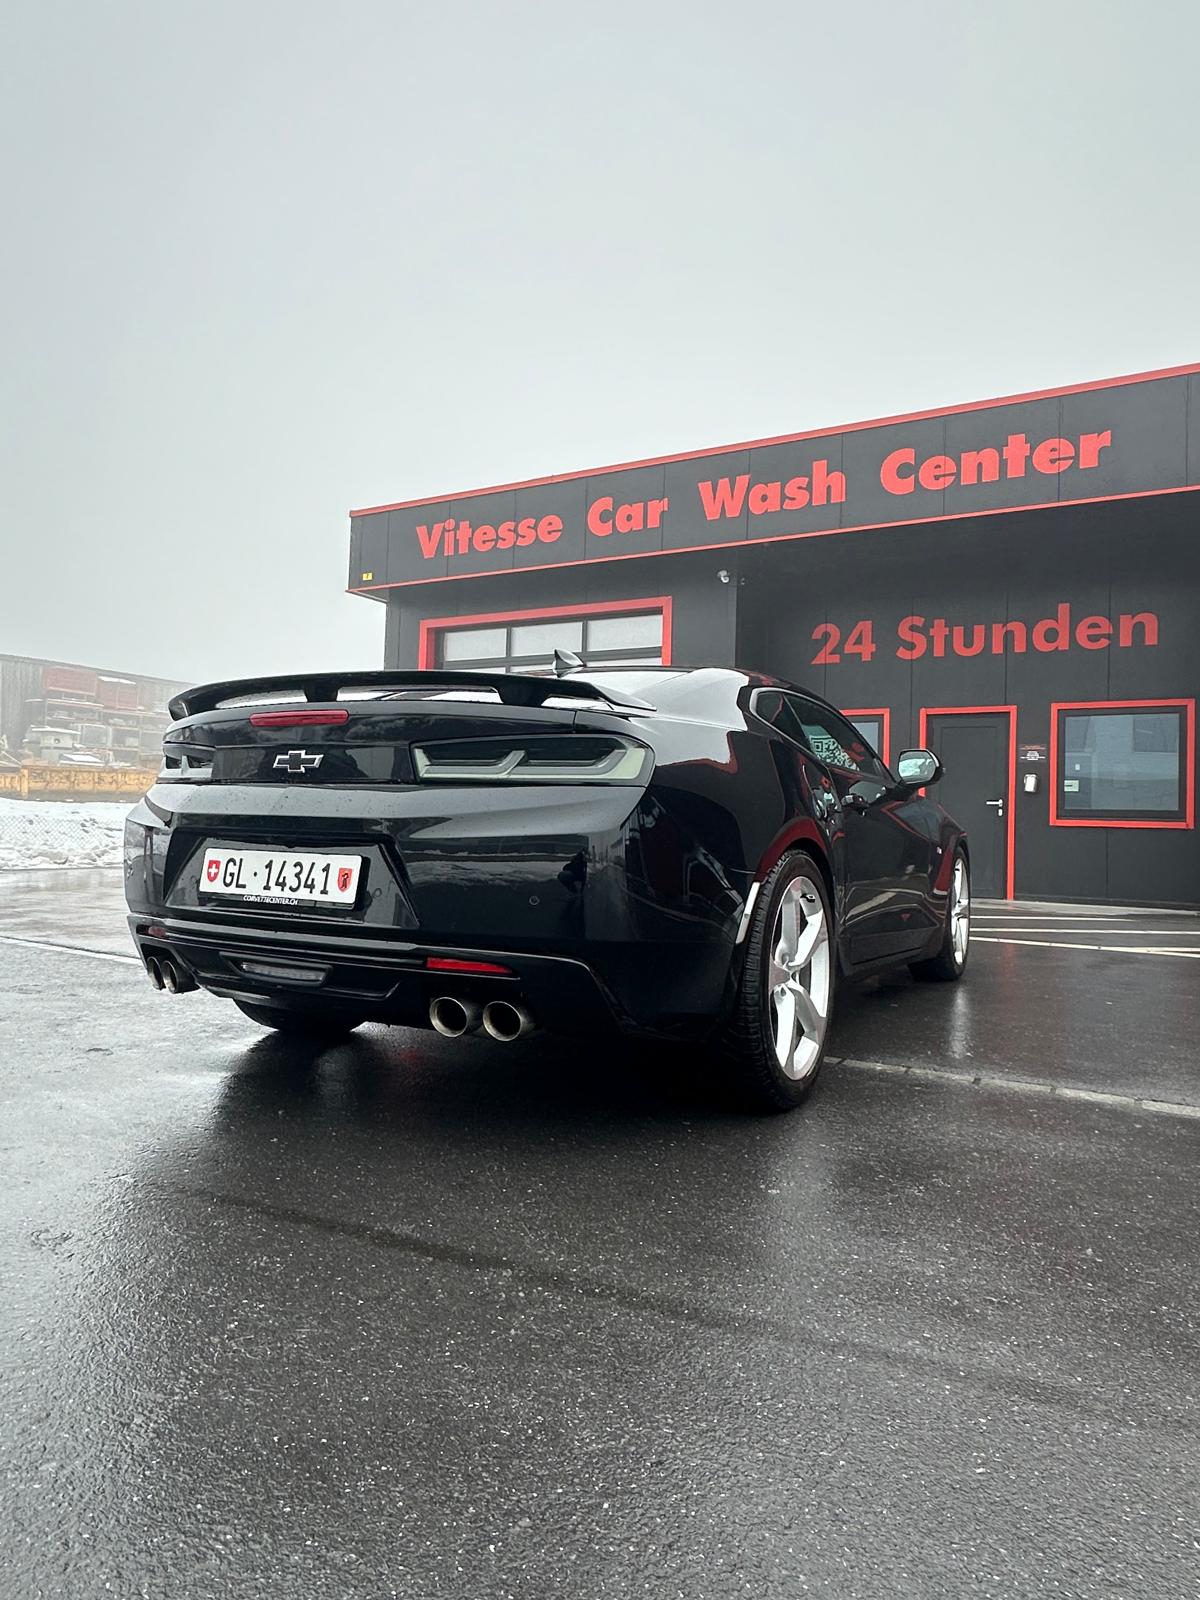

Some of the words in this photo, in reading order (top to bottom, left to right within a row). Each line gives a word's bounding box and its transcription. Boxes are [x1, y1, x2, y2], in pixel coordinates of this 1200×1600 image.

[416, 513, 563, 558] Vitesse
[587, 496, 669, 537] Car
[698, 459, 846, 521] Wash
[880, 430, 1112, 495] Center
[811, 619, 876, 665] 24
[896, 603, 1160, 660] Stunden
[223, 858, 247, 889] GL
[263, 859, 331, 895] 14341
